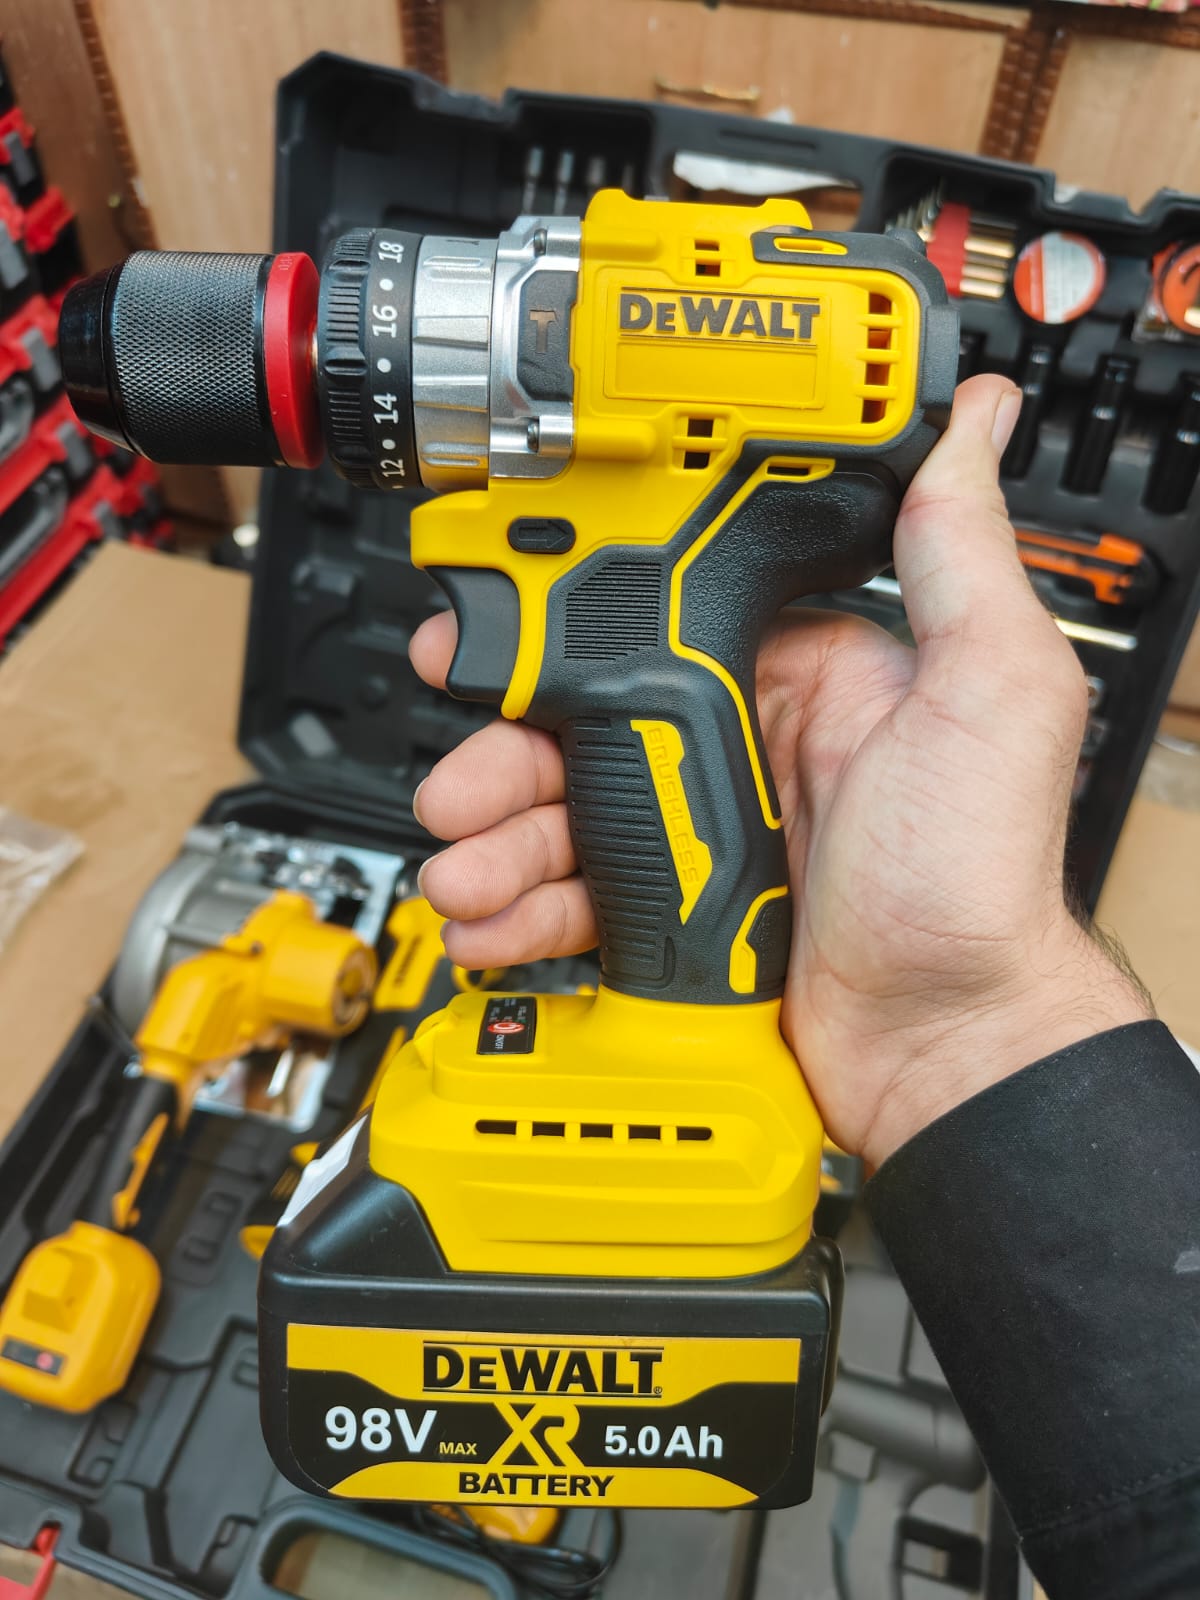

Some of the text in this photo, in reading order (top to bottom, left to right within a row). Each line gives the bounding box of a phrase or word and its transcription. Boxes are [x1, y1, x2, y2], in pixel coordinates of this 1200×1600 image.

[378, 241, 404, 264] 18
[372, 304, 398, 338] 16
[373, 392, 399, 425] 14
[380, 459, 405, 477] 12
[647, 727, 699, 884] BRUSHLESS
[325, 1405, 478, 1455] 98V MAX
[487, 1402, 586, 1466] XR
[458, 1472, 614, 1497] BATTERY
